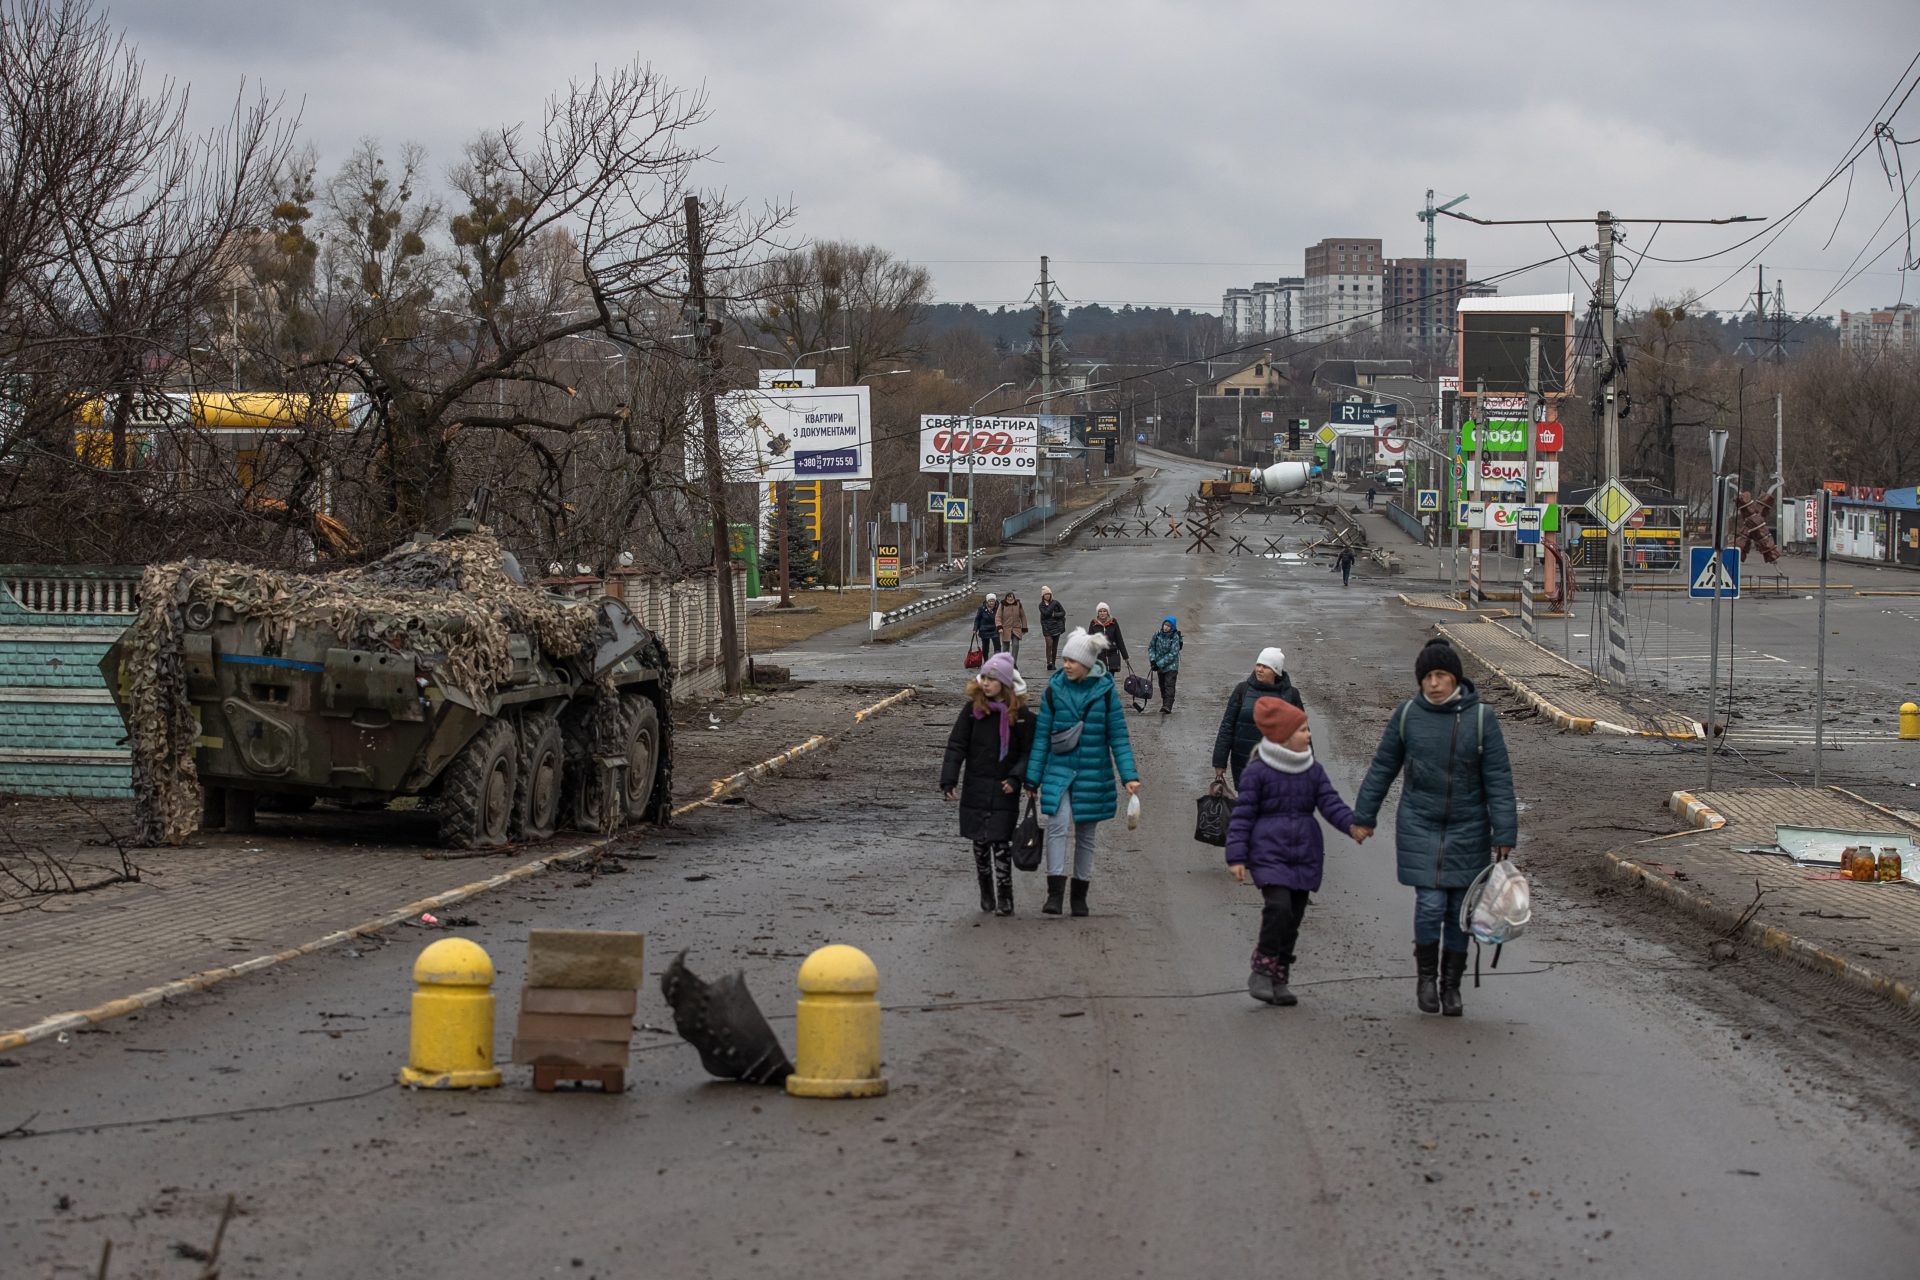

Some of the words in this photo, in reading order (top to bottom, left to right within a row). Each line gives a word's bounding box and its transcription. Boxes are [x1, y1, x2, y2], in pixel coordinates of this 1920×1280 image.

[805, 413, 844, 424] КВАРТИРИ
[1342, 405, 1355, 420] R
[926, 418, 961, 429] СВОЯ
[800, 425, 857, 439] ДОКУМЕНТАМИ
[797, 457, 816, 468] +380
[822, 457, 835, 467] 777
[835, 457, 844, 467] 55
[845, 456, 854, 466] 50
[926, 454, 954, 465] 067
[958, 455, 987, 466] 960
[991, 456, 1011, 467] 09
[1016, 457, 1036, 468] 09
[879, 546, 898, 555] KLO
